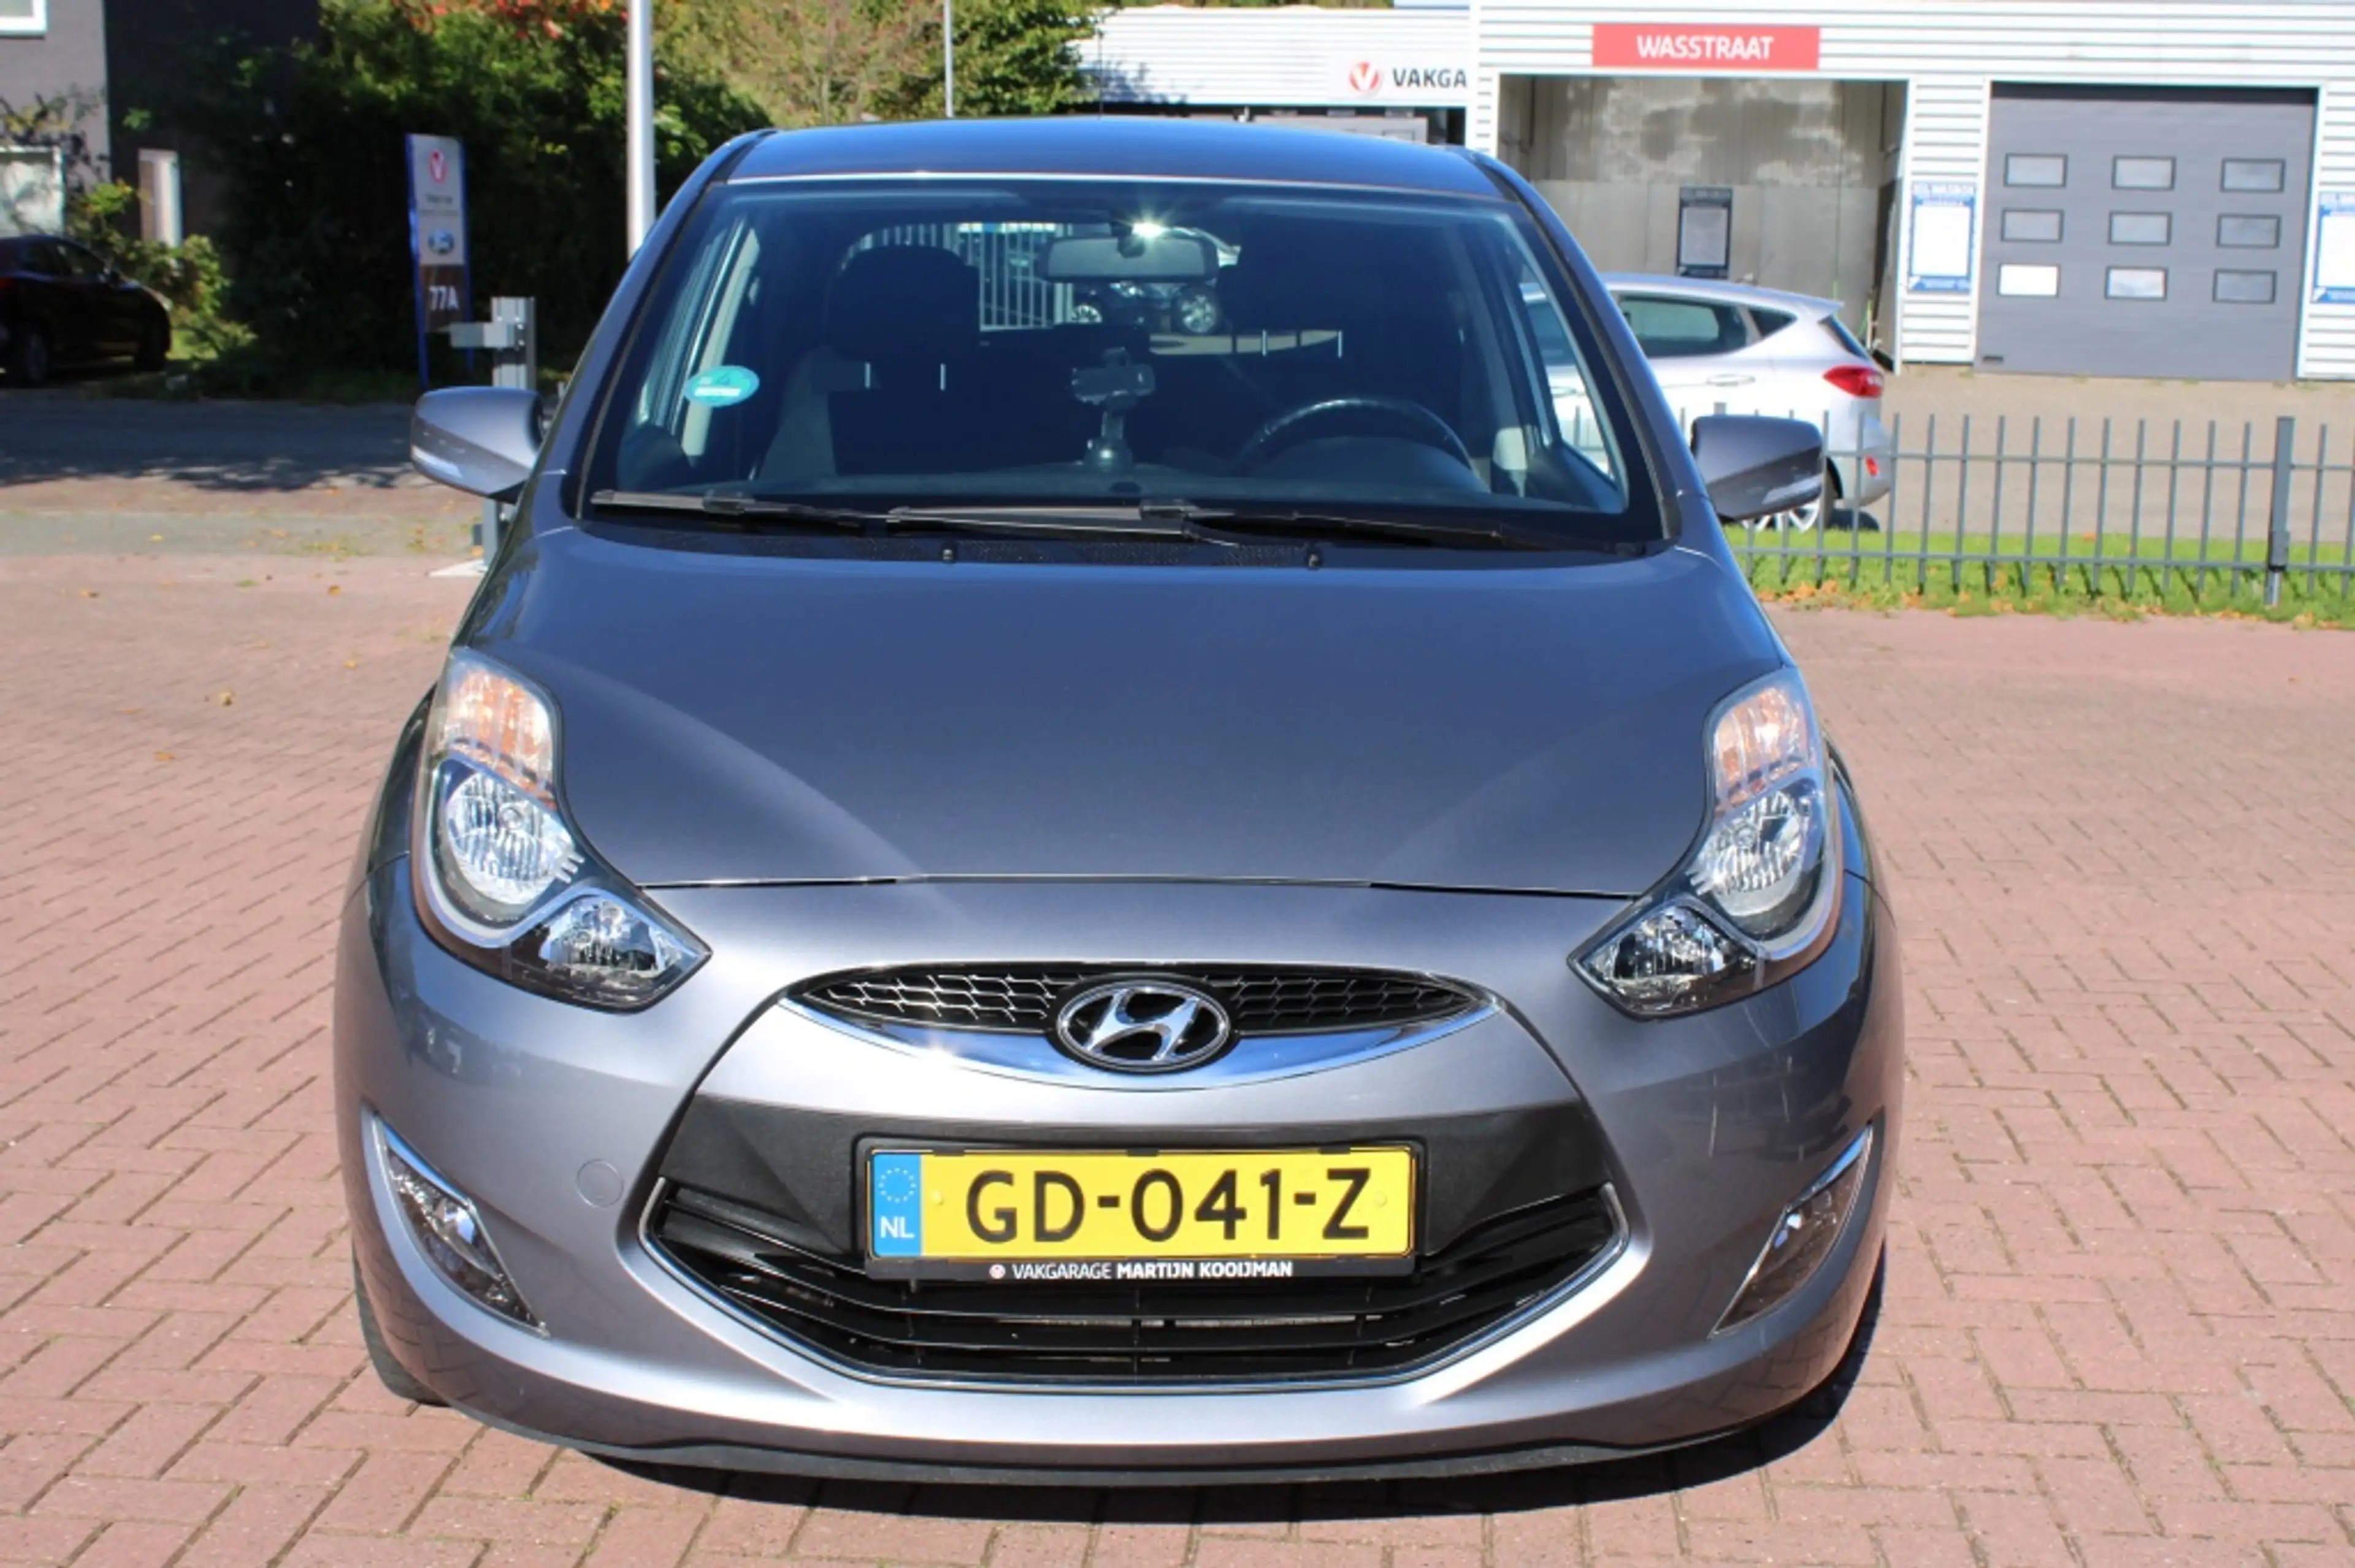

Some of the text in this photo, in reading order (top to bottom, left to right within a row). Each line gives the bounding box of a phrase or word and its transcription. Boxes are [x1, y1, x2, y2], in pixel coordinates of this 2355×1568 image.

[1636, 34, 1774, 60] WASSTRAAT
[1392, 68, 1467, 88] VAKGA
[429, 286, 459, 310] 77A
[966, 1168, 1373, 1243] GD-041-Z
[880, 1216, 916, 1239] NL
[1012, 1260, 1293, 1279] VAKGARAGE MARTIJN KOOIJMAN
